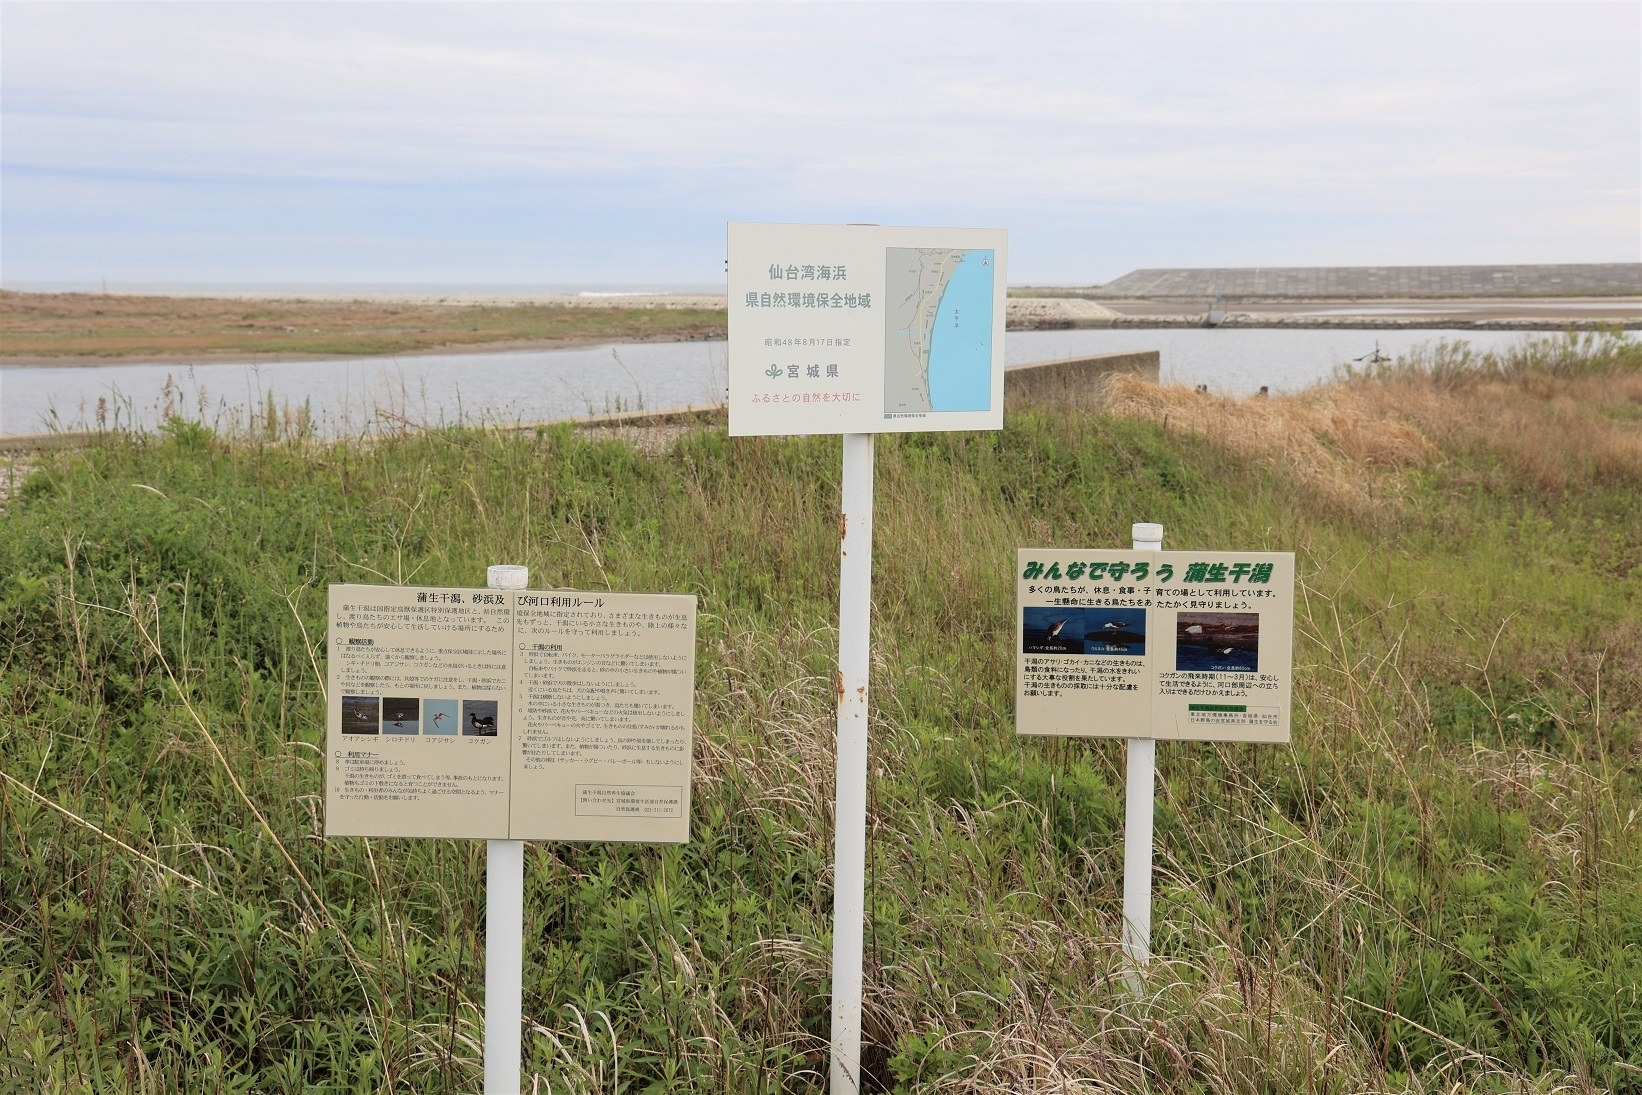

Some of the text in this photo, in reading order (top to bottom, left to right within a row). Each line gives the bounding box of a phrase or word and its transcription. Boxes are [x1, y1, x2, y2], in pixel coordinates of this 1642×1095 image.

[768, 264, 847, 281] 仙台湾海浜
[745, 292, 871, 308] 県自然環境保全地域
[764, 338, 851, 347] 昭和48年8月17日指定
[787, 363, 839, 378] 宮城県
[751, 392, 861, 403] ふるさとの自然を大切に
[1022, 561, 1274, 584] みんなで守ろう 蒲生干潟
[1023, 689, 1063, 697] お願いします。
